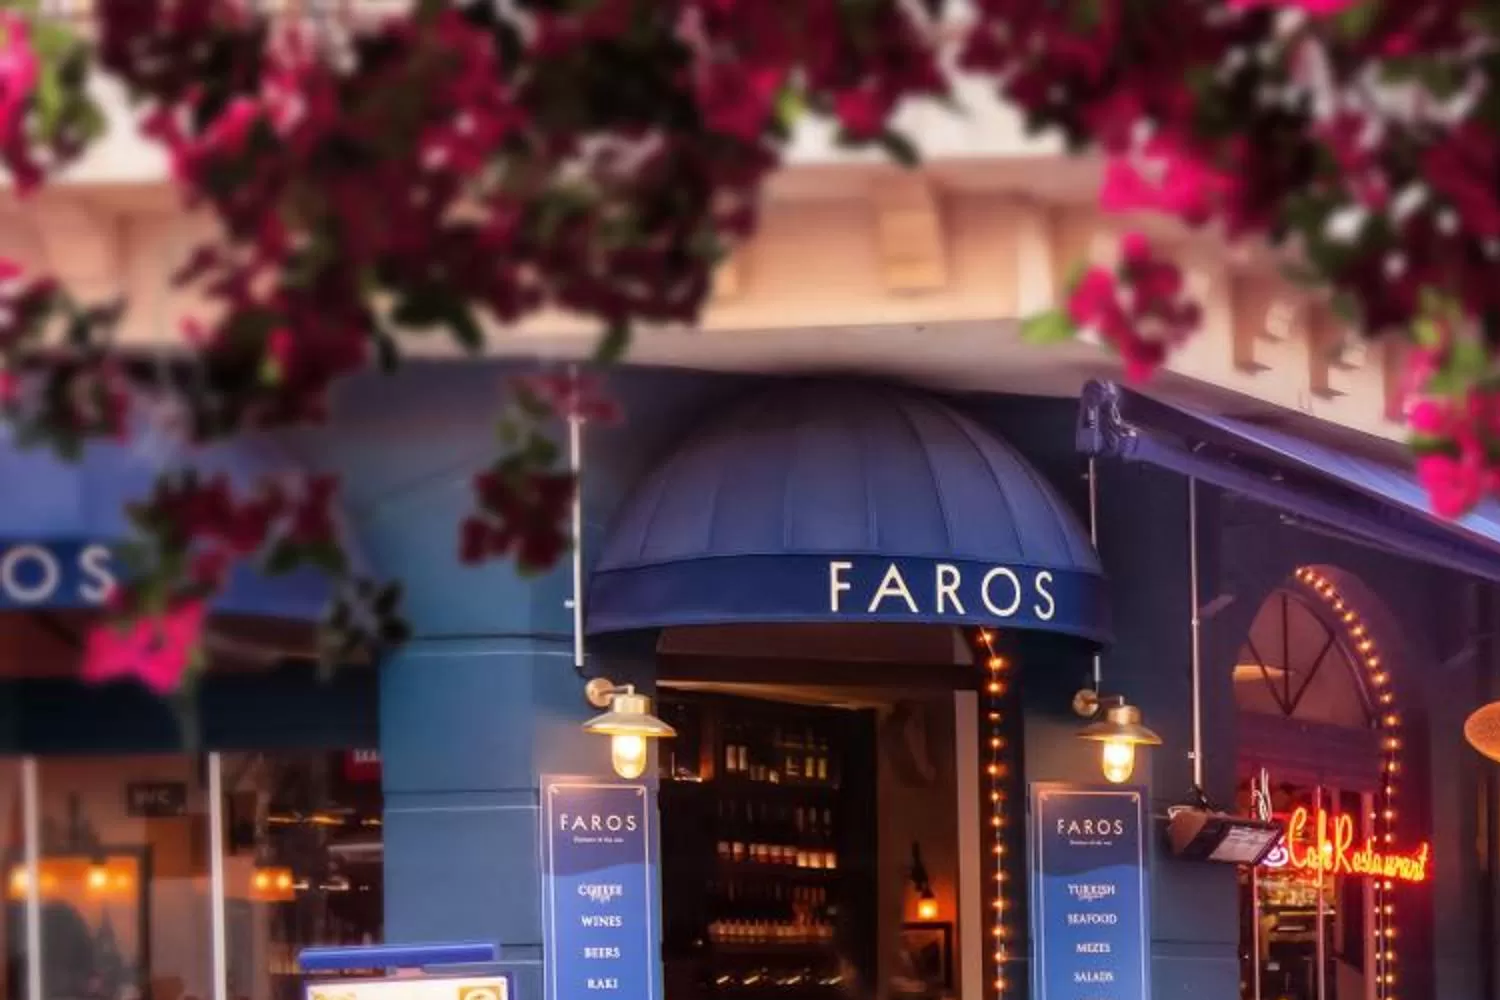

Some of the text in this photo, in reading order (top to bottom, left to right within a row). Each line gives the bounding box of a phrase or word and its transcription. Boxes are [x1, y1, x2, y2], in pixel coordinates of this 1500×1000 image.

[829, 561, 1056, 620] FAROS
[560, 814, 637, 831] FAROS
[1057, 819, 1124, 835] FAROS
[581, 915, 622, 927] WINES
[1067, 913, 1117, 925] SEAFOOD
[584, 947, 621, 959] BEERS
